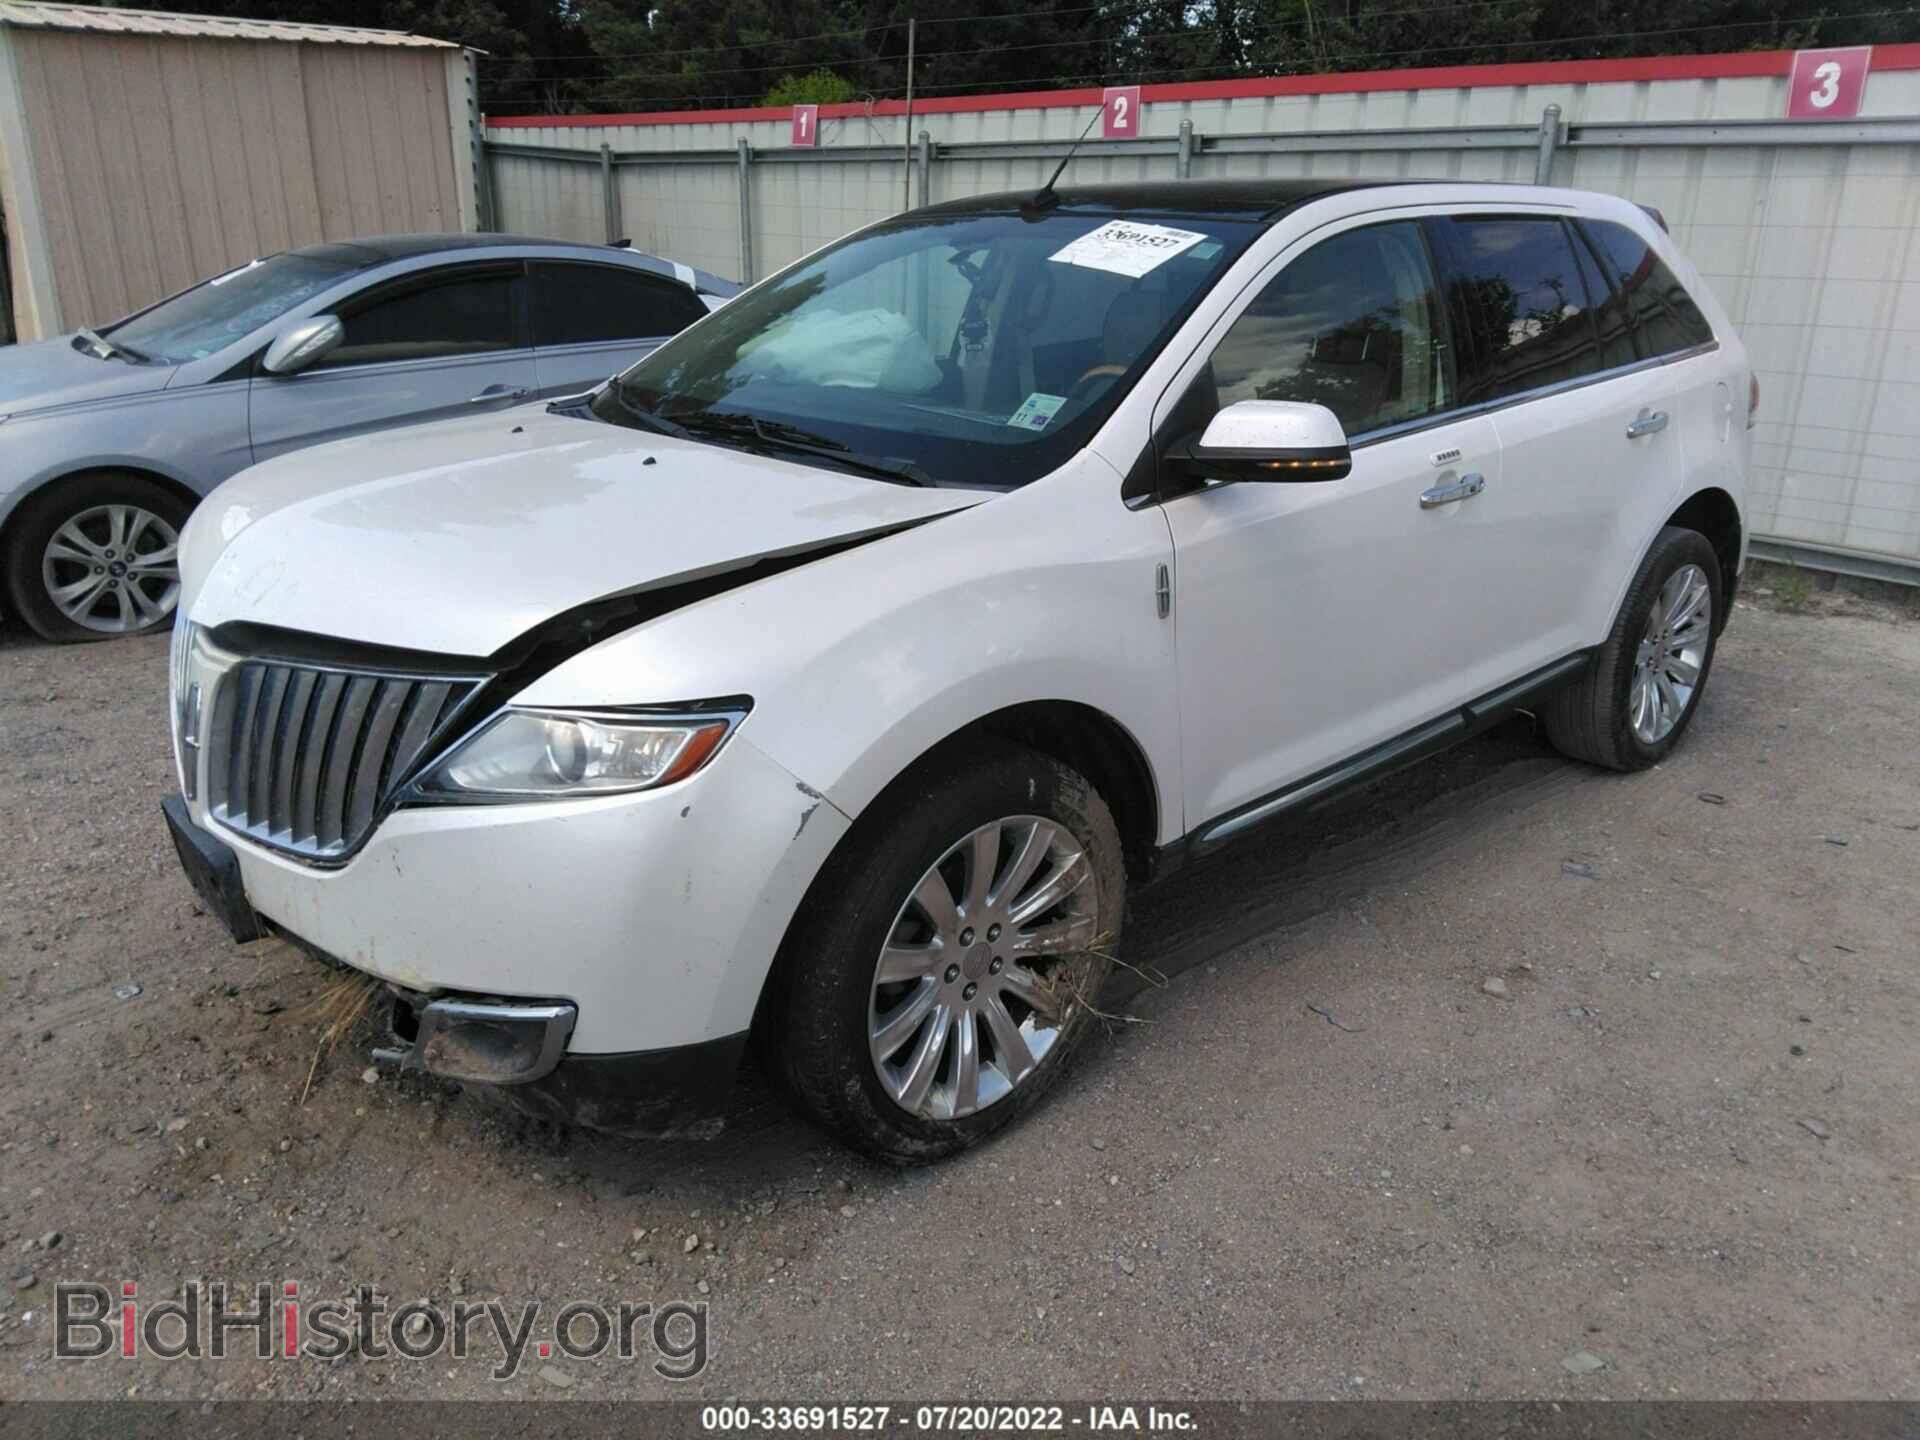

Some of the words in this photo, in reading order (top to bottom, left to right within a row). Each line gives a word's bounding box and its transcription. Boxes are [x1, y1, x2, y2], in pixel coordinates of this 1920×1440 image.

[1810, 62, 1841, 108] 3
[800, 111, 808, 137] 1
[1113, 96, 1128, 128] 2
